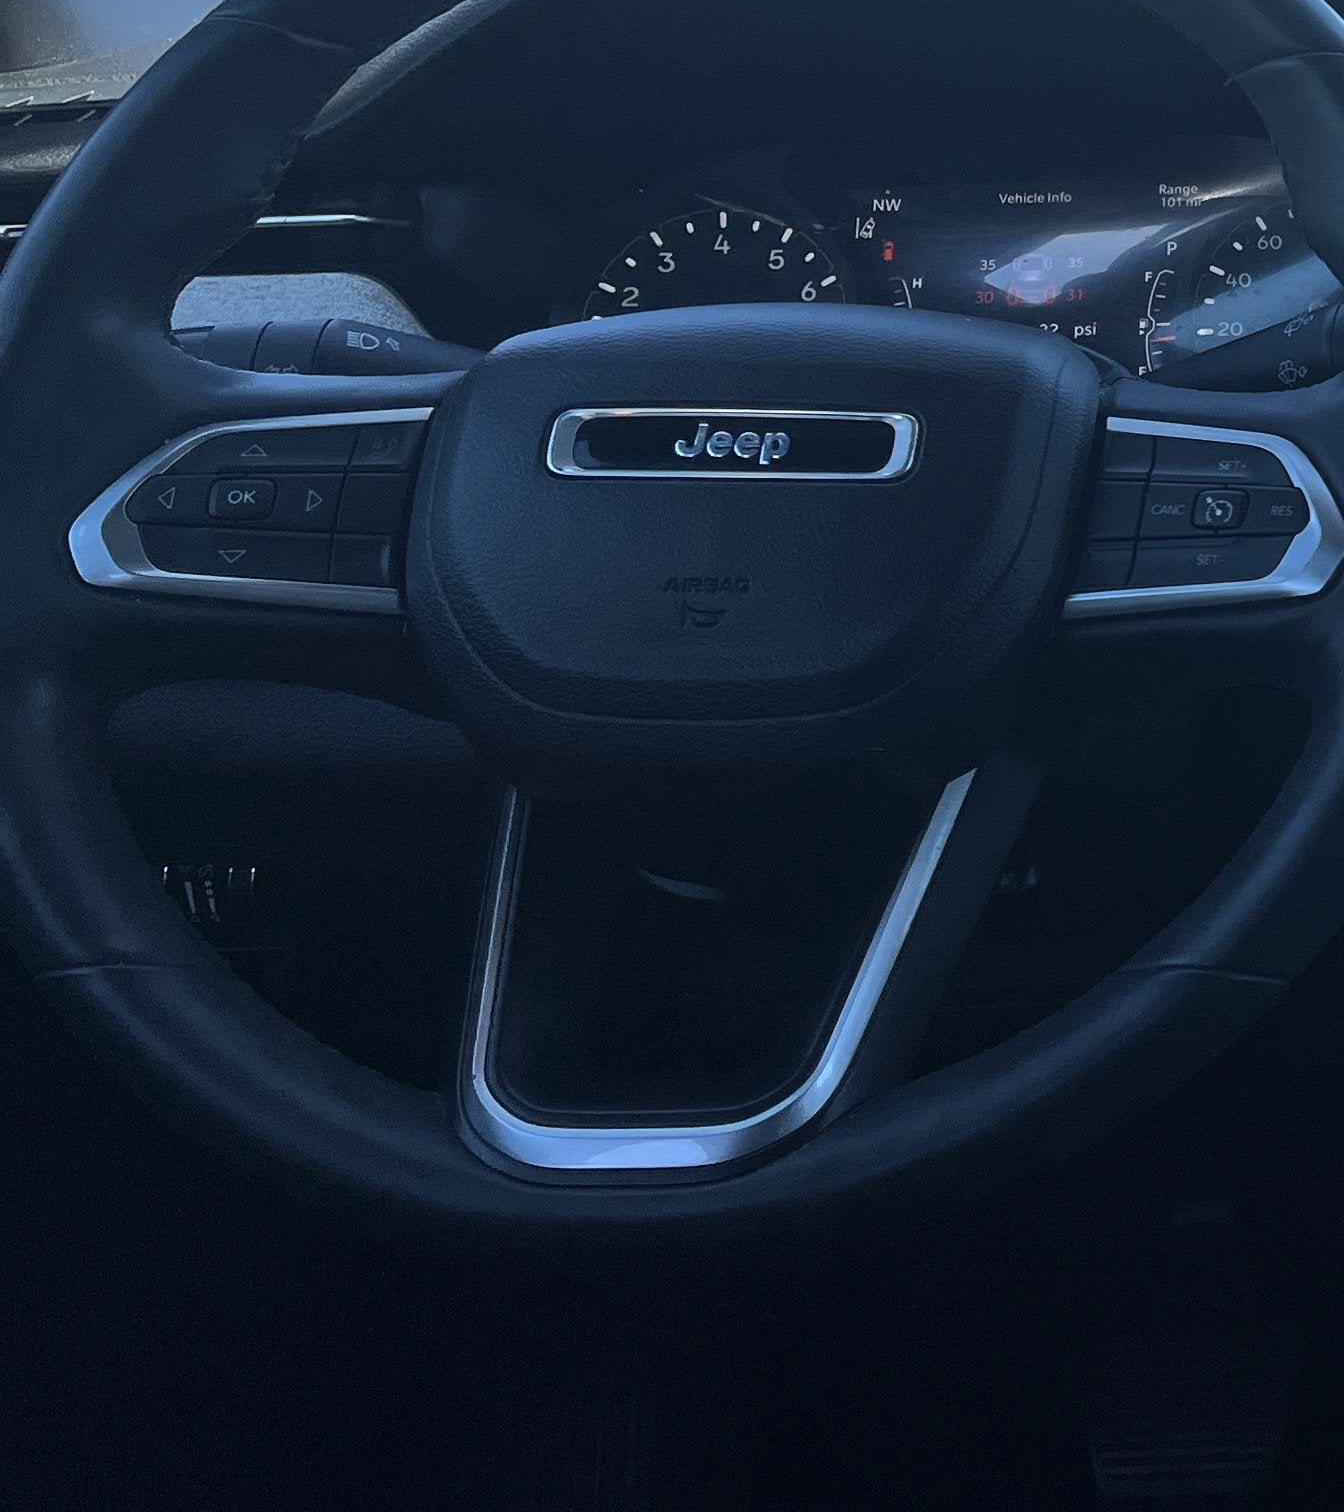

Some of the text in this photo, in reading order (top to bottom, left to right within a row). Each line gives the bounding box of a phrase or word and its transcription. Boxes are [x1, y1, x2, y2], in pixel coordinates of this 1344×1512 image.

[1158, 183, 1199, 198] Range
[873, 198, 901, 212] NW
[999, 191, 1072, 205] Vehicle Info
[1161, 197, 1185, 208] 101
[713, 235, 730, 255] 4
[1167, 242, 1178, 255] P
[1257, 235, 1283, 252] 60
[658, 252, 676, 273] 3
[768, 250, 786, 270] 5
[979, 260, 997, 271] 35
[1067, 257, 1084, 268] 35
[913, 278, 922, 289] H
[1145, 271, 1153, 282] F
[1225, 272, 1252, 289] 40
[621, 287, 640, 307] 2
[800, 282, 817, 303] 6
[975, 290, 994, 304] 30
[1066, 289, 1083, 301] 31
[1073, 321, 1097, 339] psi
[1217, 321, 1243, 337] 20
[674, 423, 791, 465] Jeep
[228, 490, 257, 505] OK
[1150, 504, 1186, 516] CANC
[1270, 506, 1294, 517] RES
